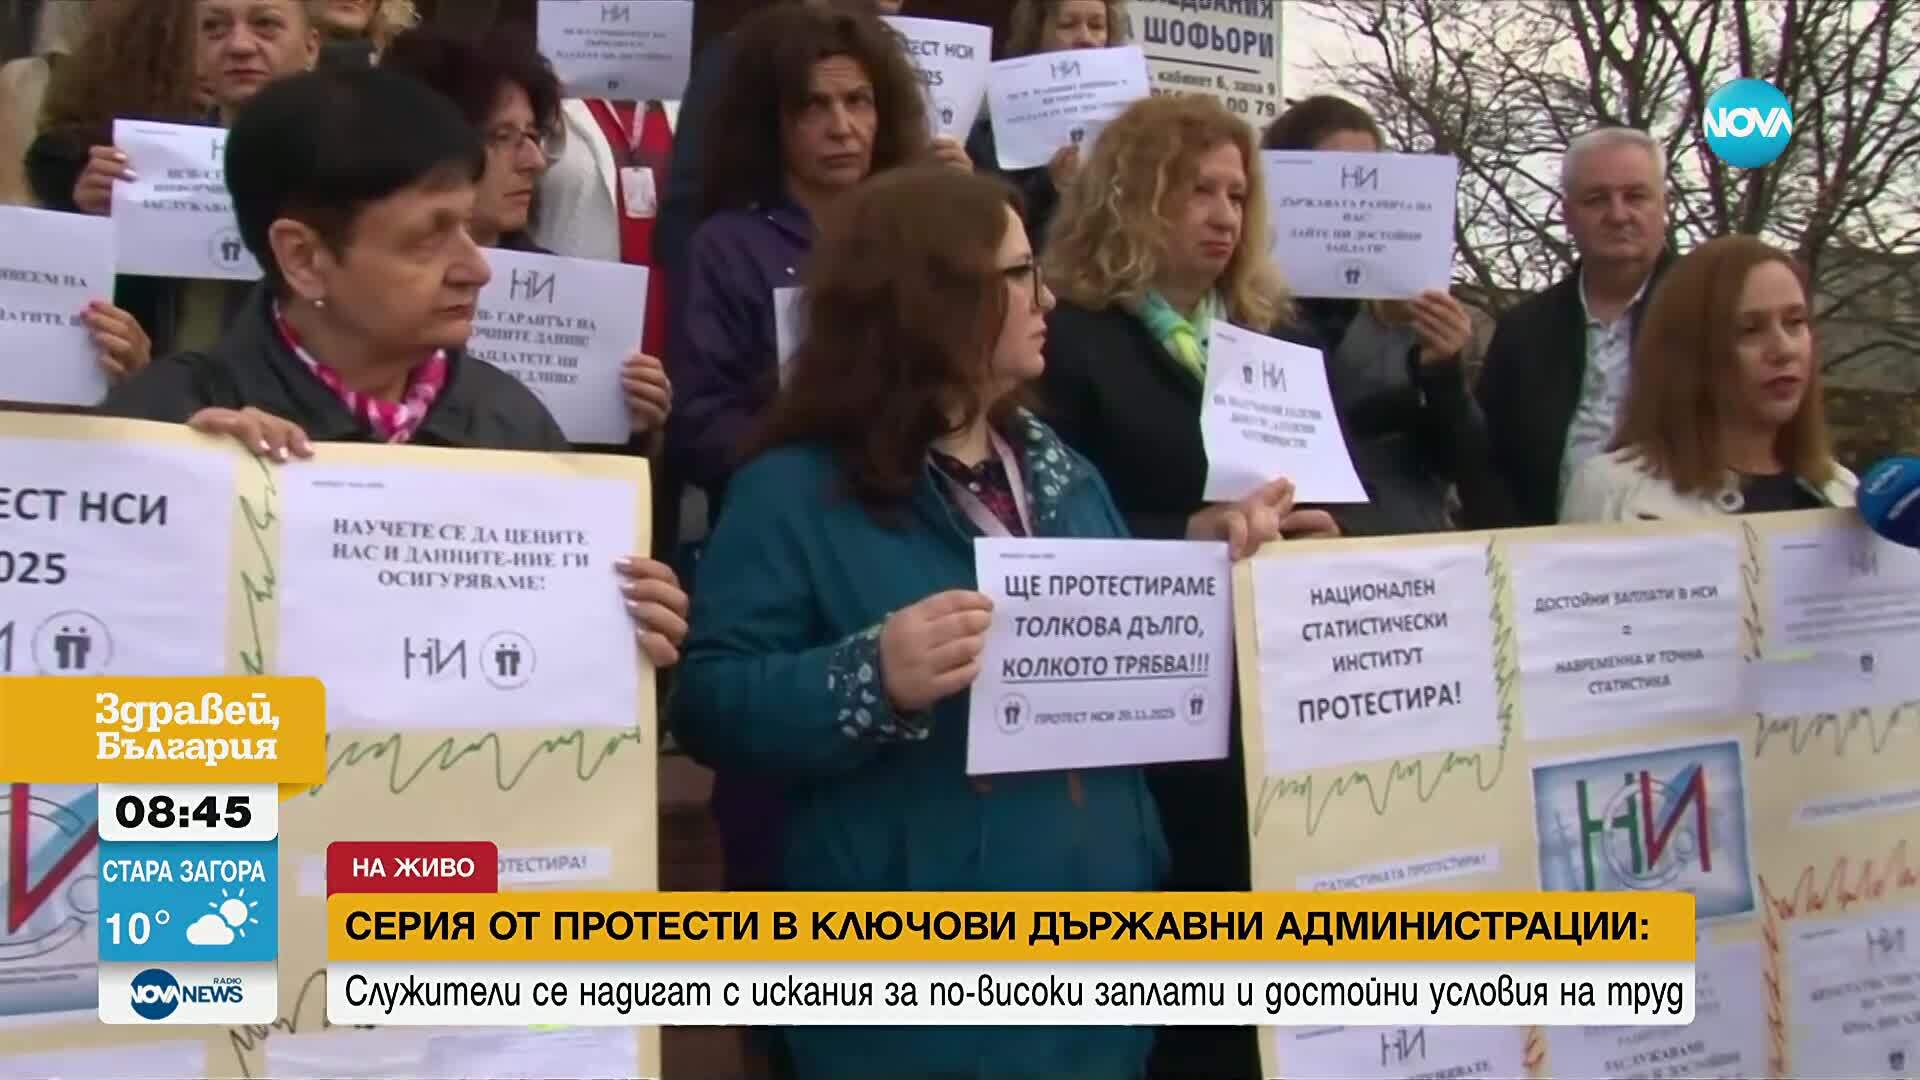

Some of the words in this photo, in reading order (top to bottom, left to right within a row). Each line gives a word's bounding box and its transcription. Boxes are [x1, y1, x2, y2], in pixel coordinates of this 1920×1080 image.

[911, 40, 939, 56] ЕСТ
[1144, 16, 1273, 58] ШОФЬОРИ
[927, 71, 943, 86] 25
[1256, 100, 1275, 116] 79
[0, 488, 67, 521] ЕСТ
[79, 490, 168, 526] НСИ
[333, 518, 434, 539] НАУЧЕТЕ
[439, 523, 466, 541] СЕ
[471, 526, 498, 544] ДА
[504, 528, 589, 546] ЦЕНИТЕ
[0, 550, 67, 585] 025
[332, 543, 379, 561] НАС
[384, 545, 399, 561] И
[563, 552, 589, 568] ГИ
[378, 570, 546, 590] ОСИГУРЯВАМЕ!
[1005, 575, 1041, 600] ЩЕ
[1050, 575, 1216, 597] ПРОТЕСТИРАМЕ
[1310, 579, 1435, 606] НАЦИОНАЛЕН
[1015, 615, 1121, 638] ТОЛКОВА
[1127, 615, 1205, 640] ДЪЛГО,
[1302, 611, 1448, 642] СТАТИСТИЧЕСКИ
[1002, 656, 1107, 678] КОЛКОТО
[1113, 653, 1209, 675] ТРЯБВА!!!
[1332, 647, 1423, 672] ИНСТИТУТ
[1298, 680, 1461, 724] ПРОТЕСТИРА!
